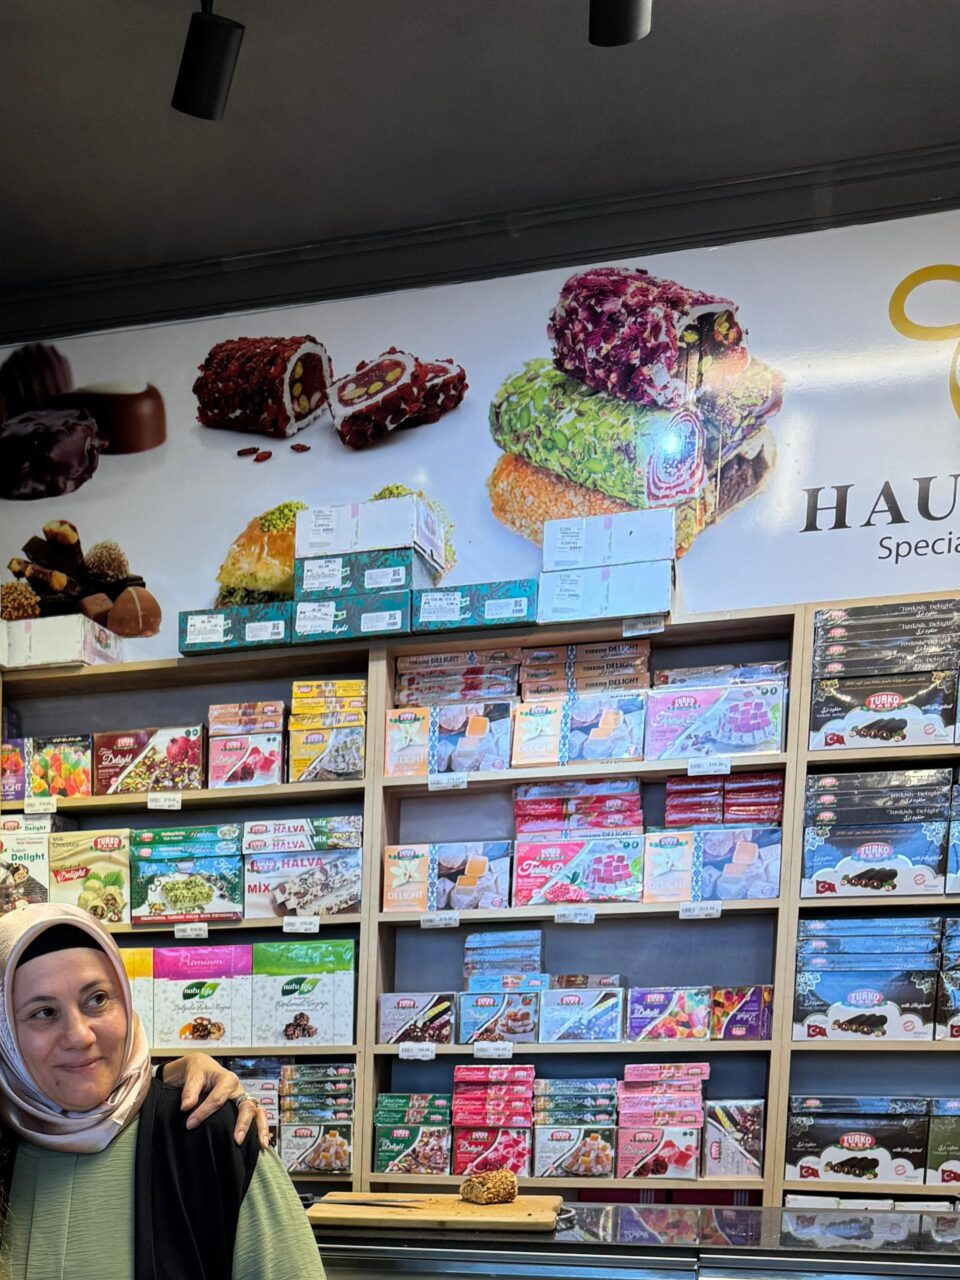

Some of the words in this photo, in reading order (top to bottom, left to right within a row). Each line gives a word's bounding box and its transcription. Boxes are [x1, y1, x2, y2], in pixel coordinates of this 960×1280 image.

[608, 677, 639, 685] DELIGHT
[869, 695, 899, 705] TURKO
[272, 825, 305, 834] HALVA
[97, 836, 119, 844] TURKO
[272, 840, 305, 850] HALVA
[861, 845, 889, 855] TURKO
[11, 852, 45, 862] Delight
[281, 857, 325, 869] HALVA
[57, 867, 87, 880] Delight
[247, 881, 271, 894] MİX
[178, 954, 224, 967] Premium
[200, 986, 213, 997] life
[283, 981, 300, 991] natu
[300, 982, 313, 992] life
[851, 992, 880, 1001] TURKO
[843, 1135, 872, 1144] TURKO
